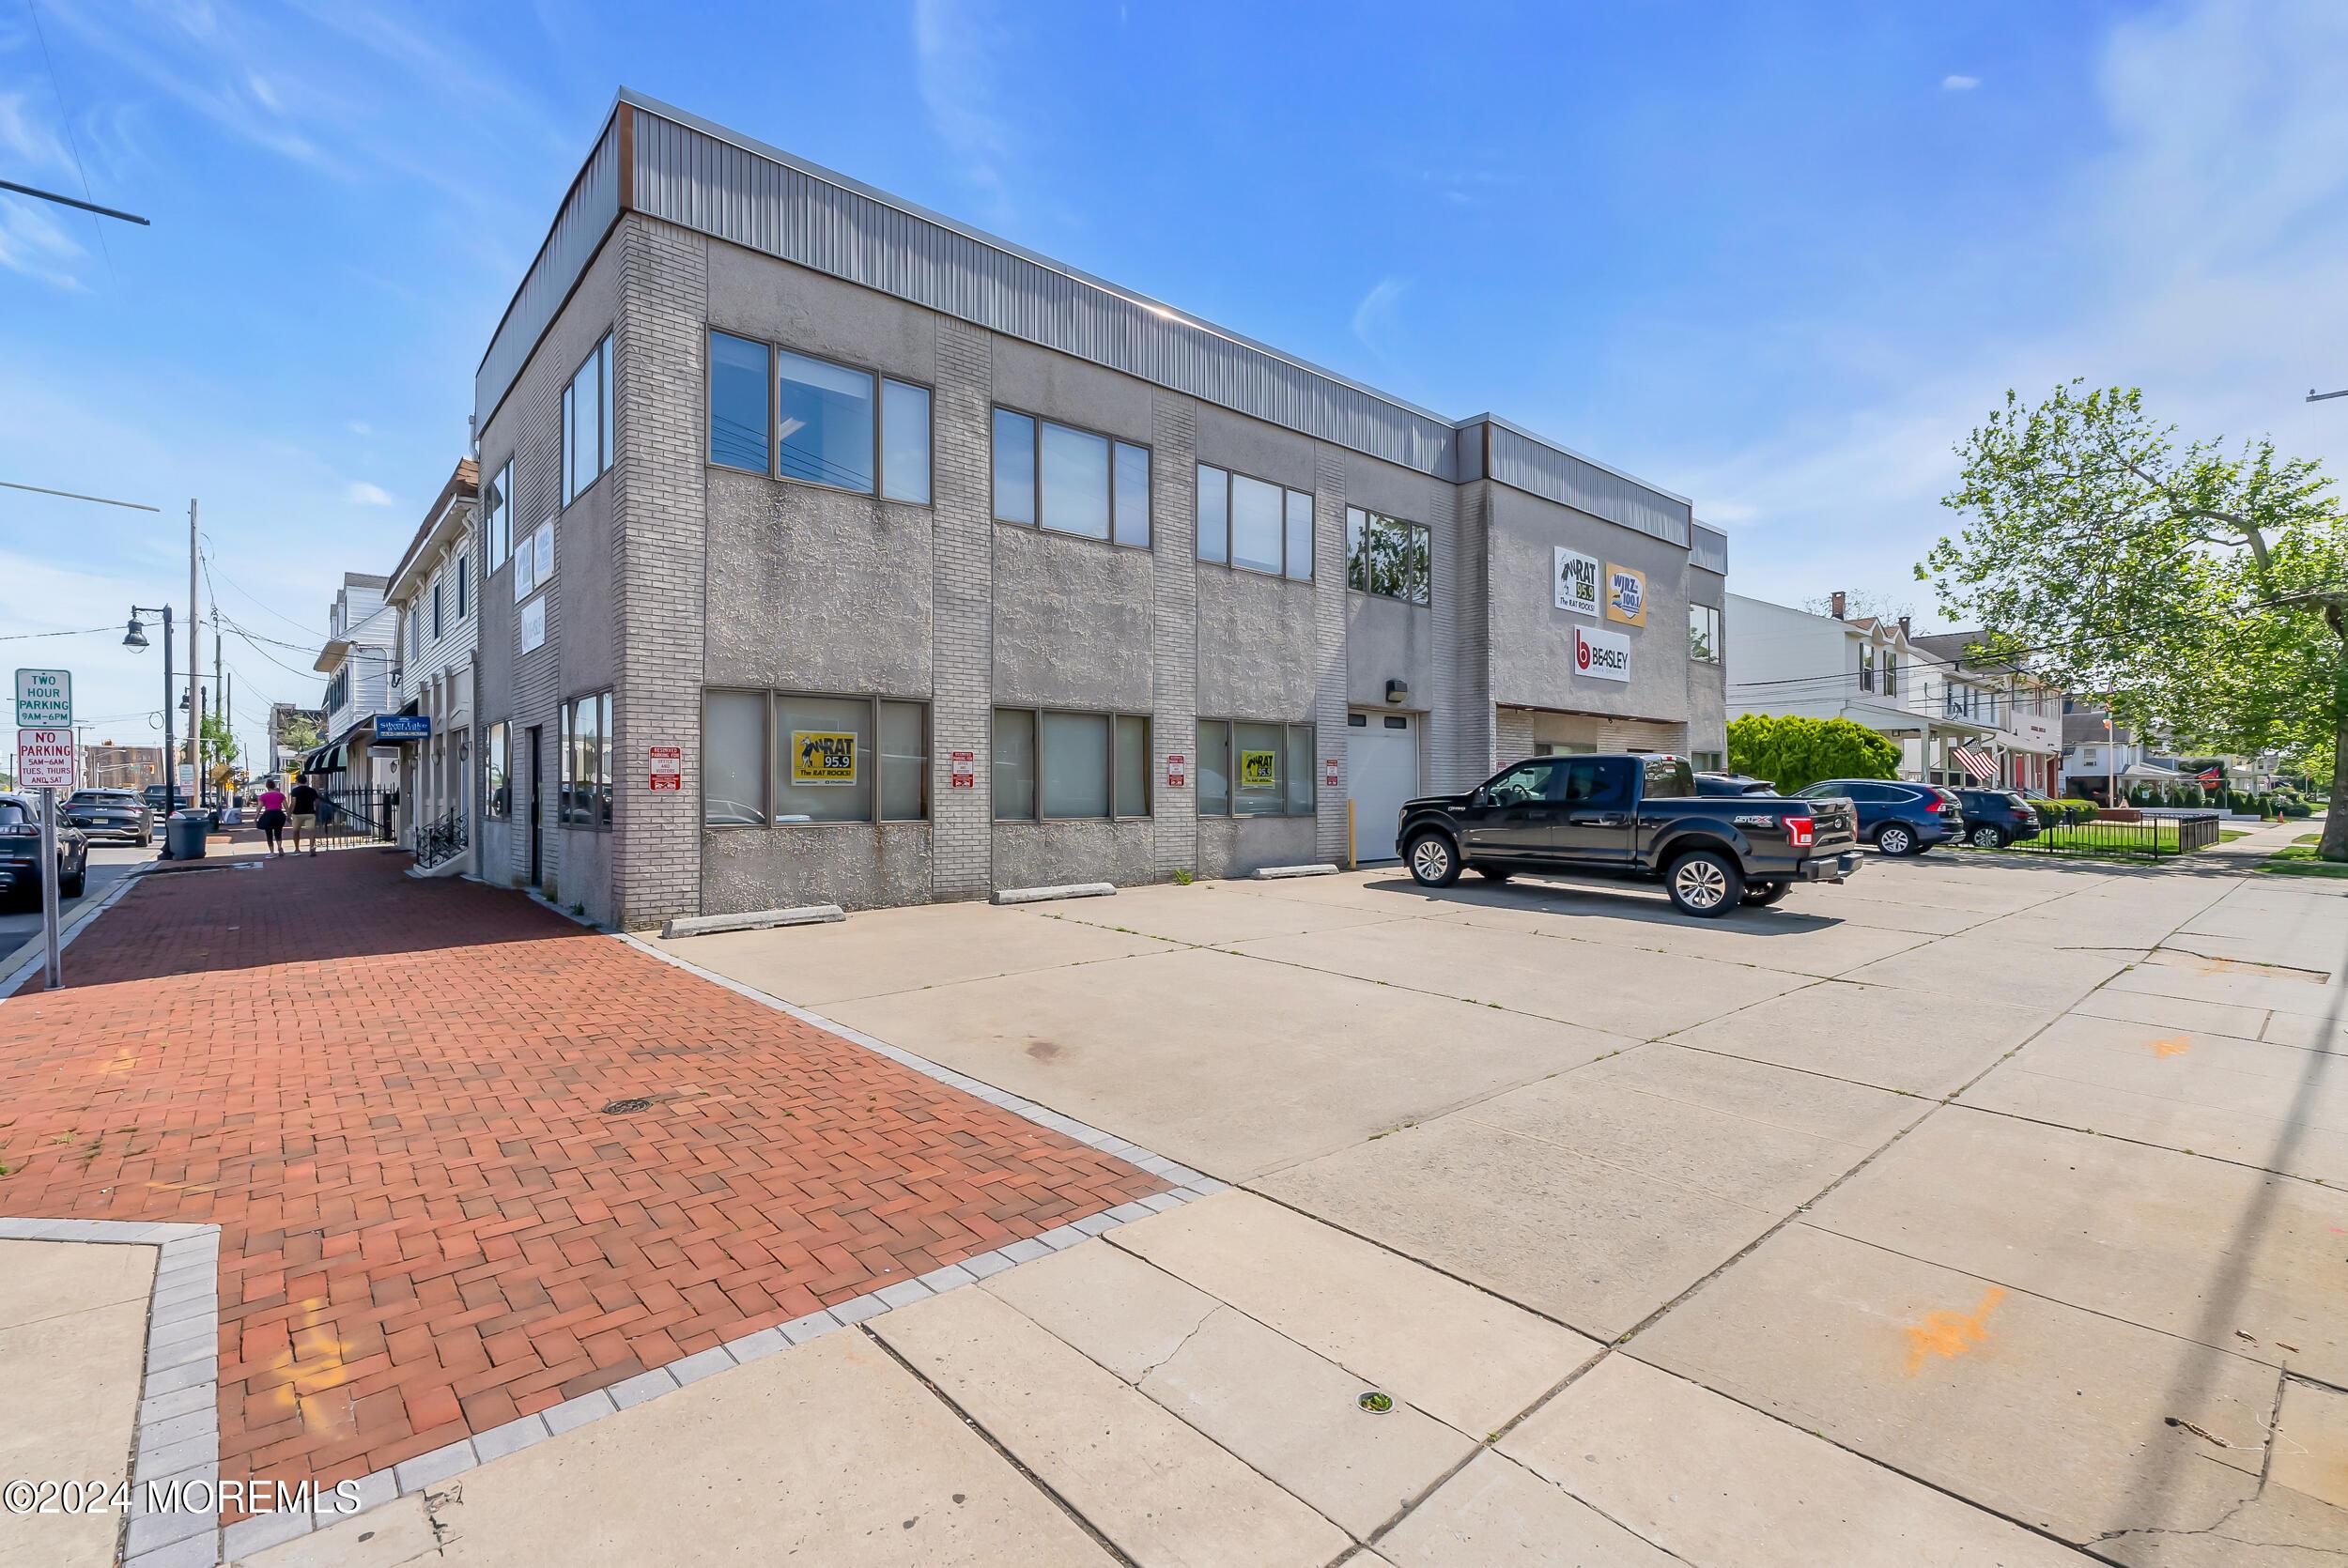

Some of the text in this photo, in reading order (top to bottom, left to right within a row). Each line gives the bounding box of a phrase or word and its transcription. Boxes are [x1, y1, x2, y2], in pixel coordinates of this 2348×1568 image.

[1576, 559, 1596, 585] RAT
[1614, 574, 1638, 593] WJRZ
[1577, 583, 1594, 600] 95.9
[1624, 592, 1640, 607] 100.1
[1579, 602, 1595, 611] ROCKS!
[1593, 647, 1629, 669] BEASLEY
[32, 676, 56, 685] TWO
[27, 688, 60, 698] HOUR
[20, 700, 69, 711] PARKING
[22, 713, 68, 721] 9AM-6PM
[36, 732, 56, 744] NO
[22, 746, 70, 757] PARKING
[824, 738, 854, 755] RAT
[825, 756, 850, 768] 95.9
[1258, 756, 1273, 766] RAT
[1259, 768, 1271, 776] 95.9
